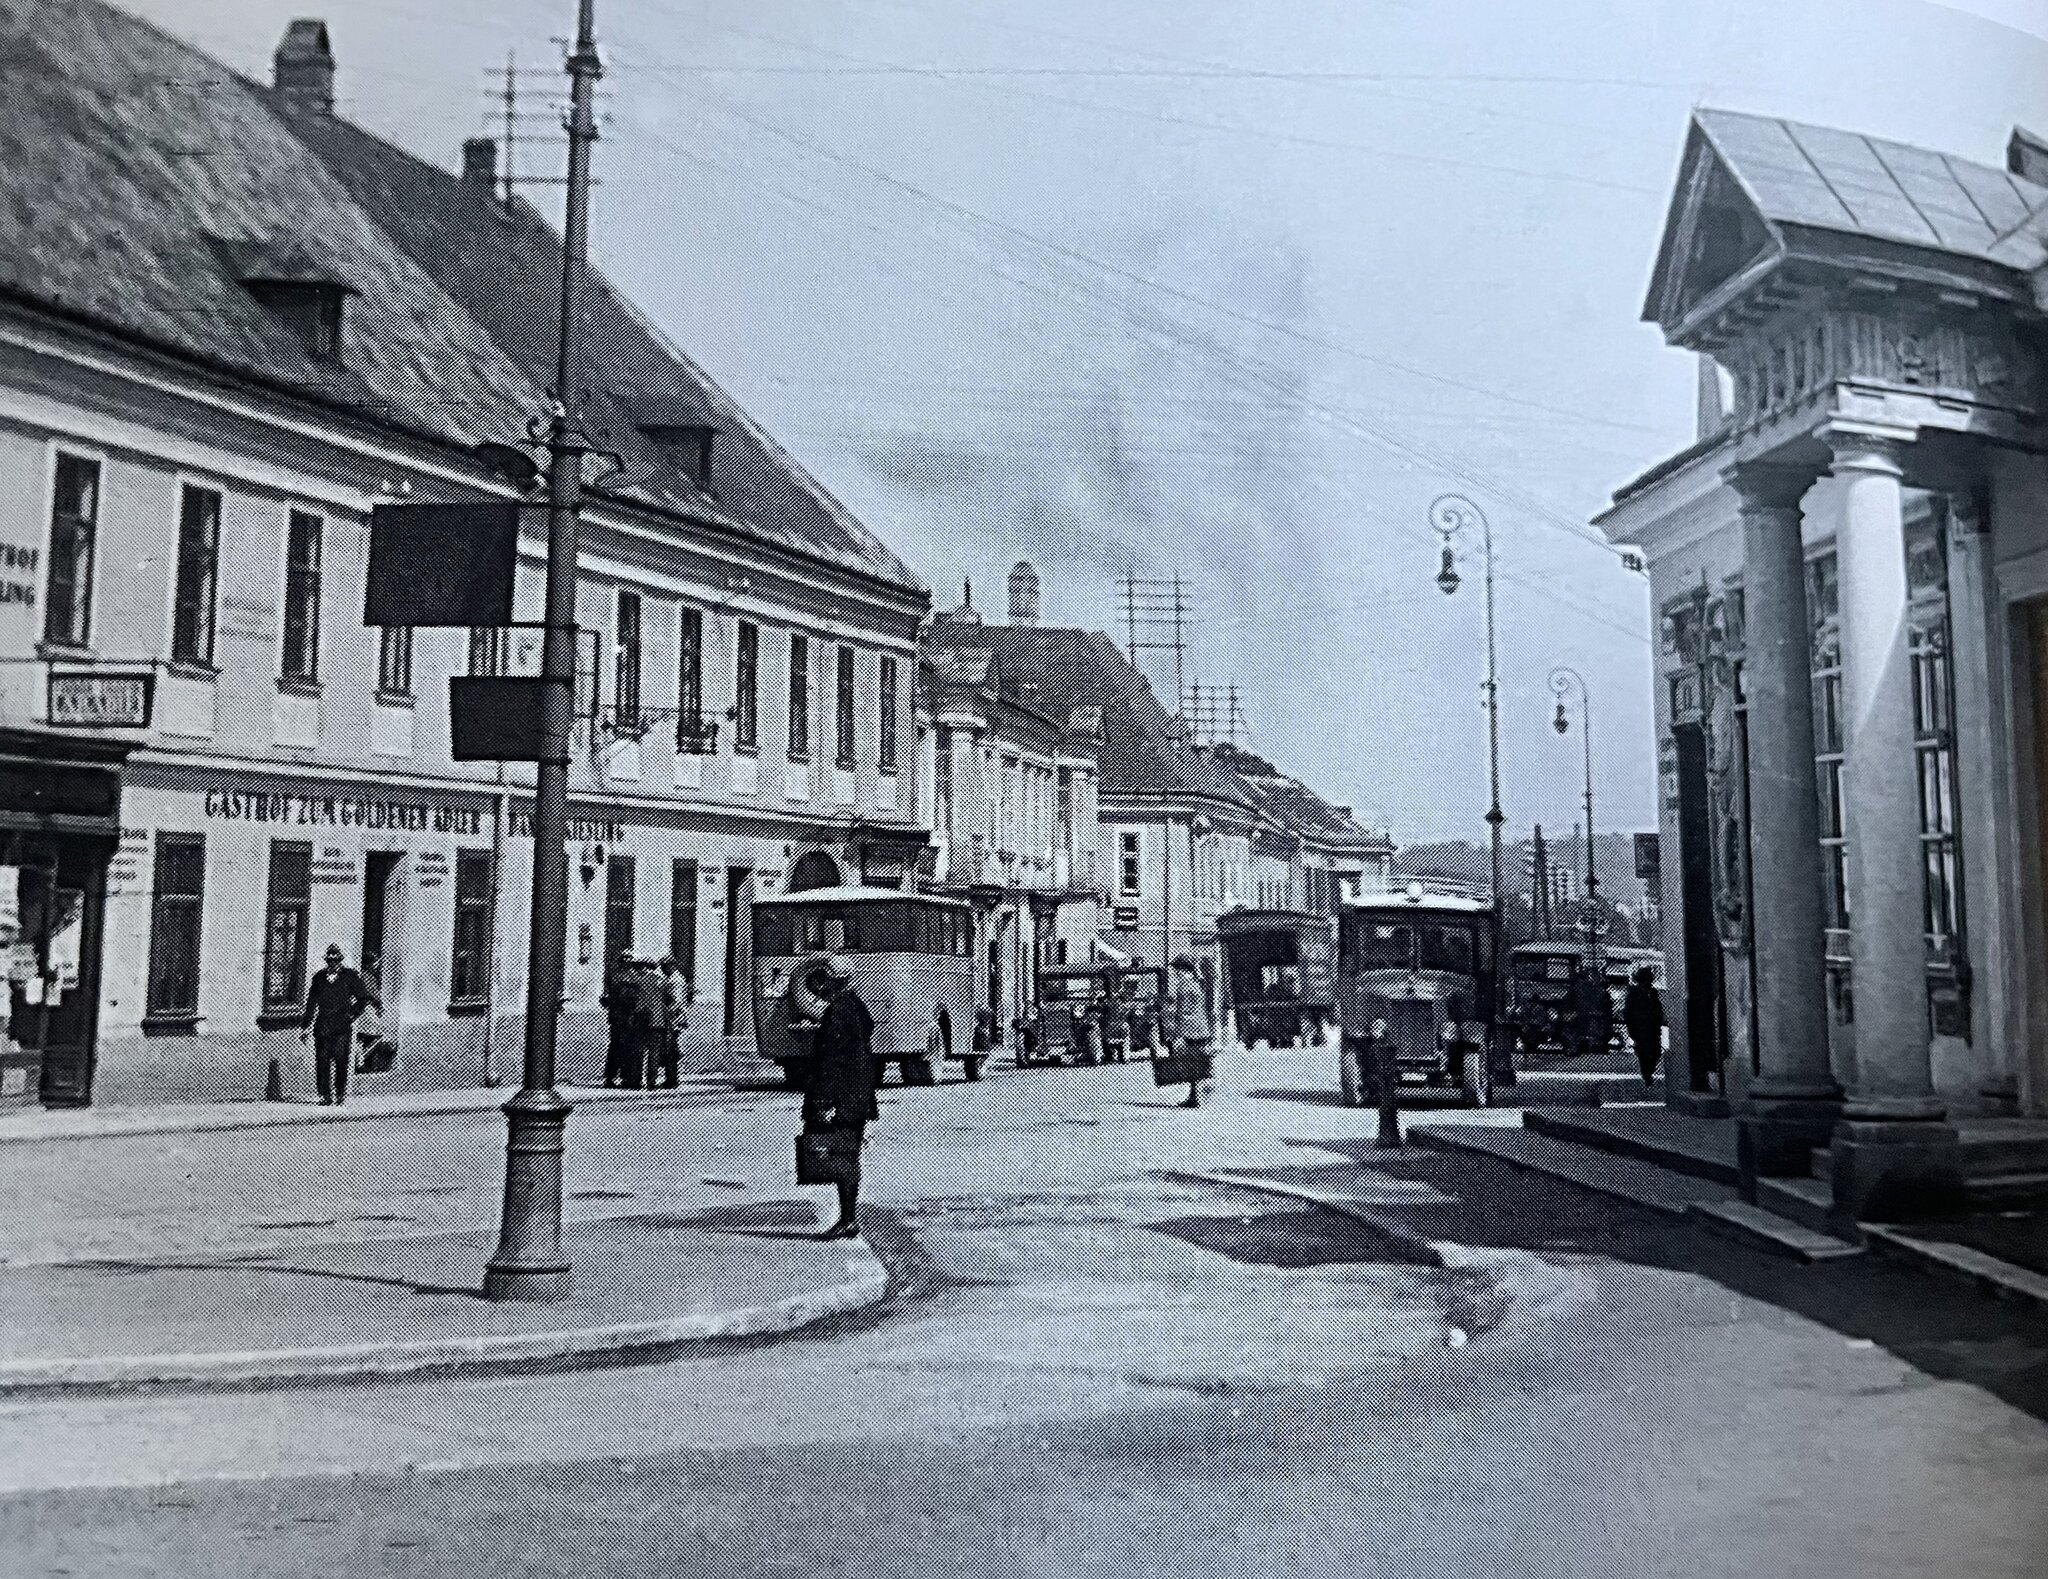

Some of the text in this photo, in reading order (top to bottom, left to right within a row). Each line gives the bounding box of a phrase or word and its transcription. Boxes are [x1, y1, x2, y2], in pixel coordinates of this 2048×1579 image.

[206, 788, 292, 823] GASTHOF
[297, 795, 336, 825] ZUM
[341, 798, 428, 832] GOLDENEN
[433, 806, 481, 835] ADLER
